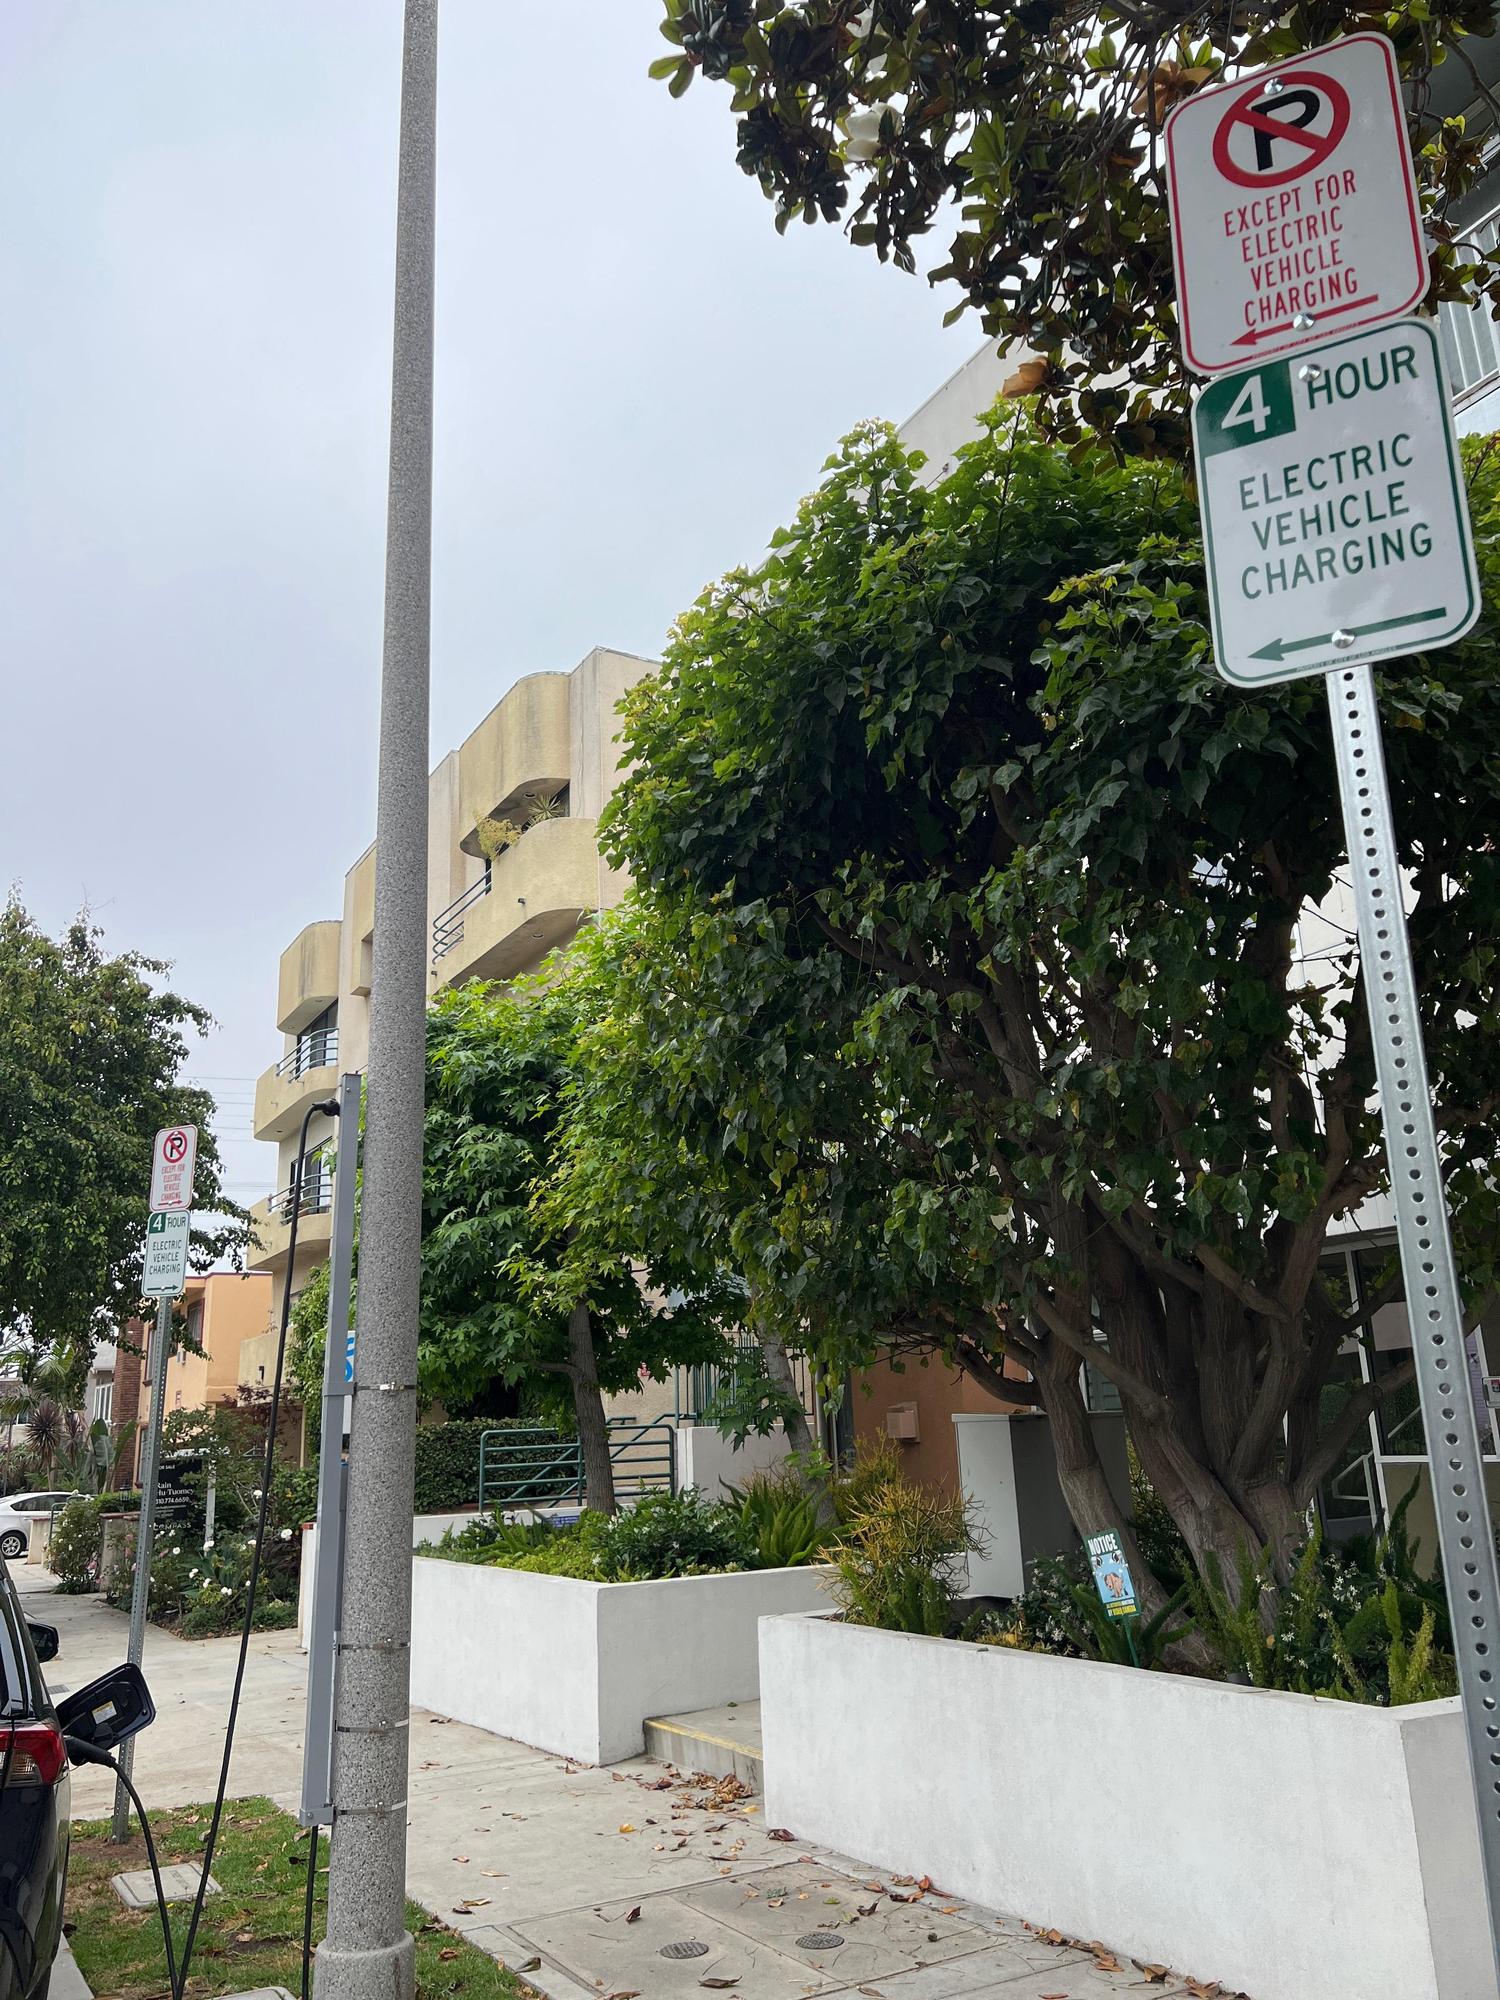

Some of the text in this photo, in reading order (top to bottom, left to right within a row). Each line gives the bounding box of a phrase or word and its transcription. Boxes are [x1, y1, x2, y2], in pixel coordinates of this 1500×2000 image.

[1224, 169, 1356, 237] EXCEPT FOR
[1242, 206, 1344, 263] ELECTRIC
[1251, 239, 1344, 291] VEHICLE
[1244, 267, 1359, 327] CHARGING
[1221, 345, 1420, 433] 4 HOUR
[1239, 433, 1413, 511] ELECTRIC
[1251, 481, 1409, 550] VEHICLE
[1241, 522, 1432, 600] CHARGING
[161, 1192, 181, 1201] CHARGING
[163, 1173, 181, 1182] ELECTRIC
[153, 1214, 186, 1231] 4 HOUR
[153, 1240, 182, 1251] ELECTRIC
[149, 1263, 181, 1275] CHARGING
[153, 1252, 179, 1262] VEHICLE
[1088, 1533, 1118, 1555] NOTICE
